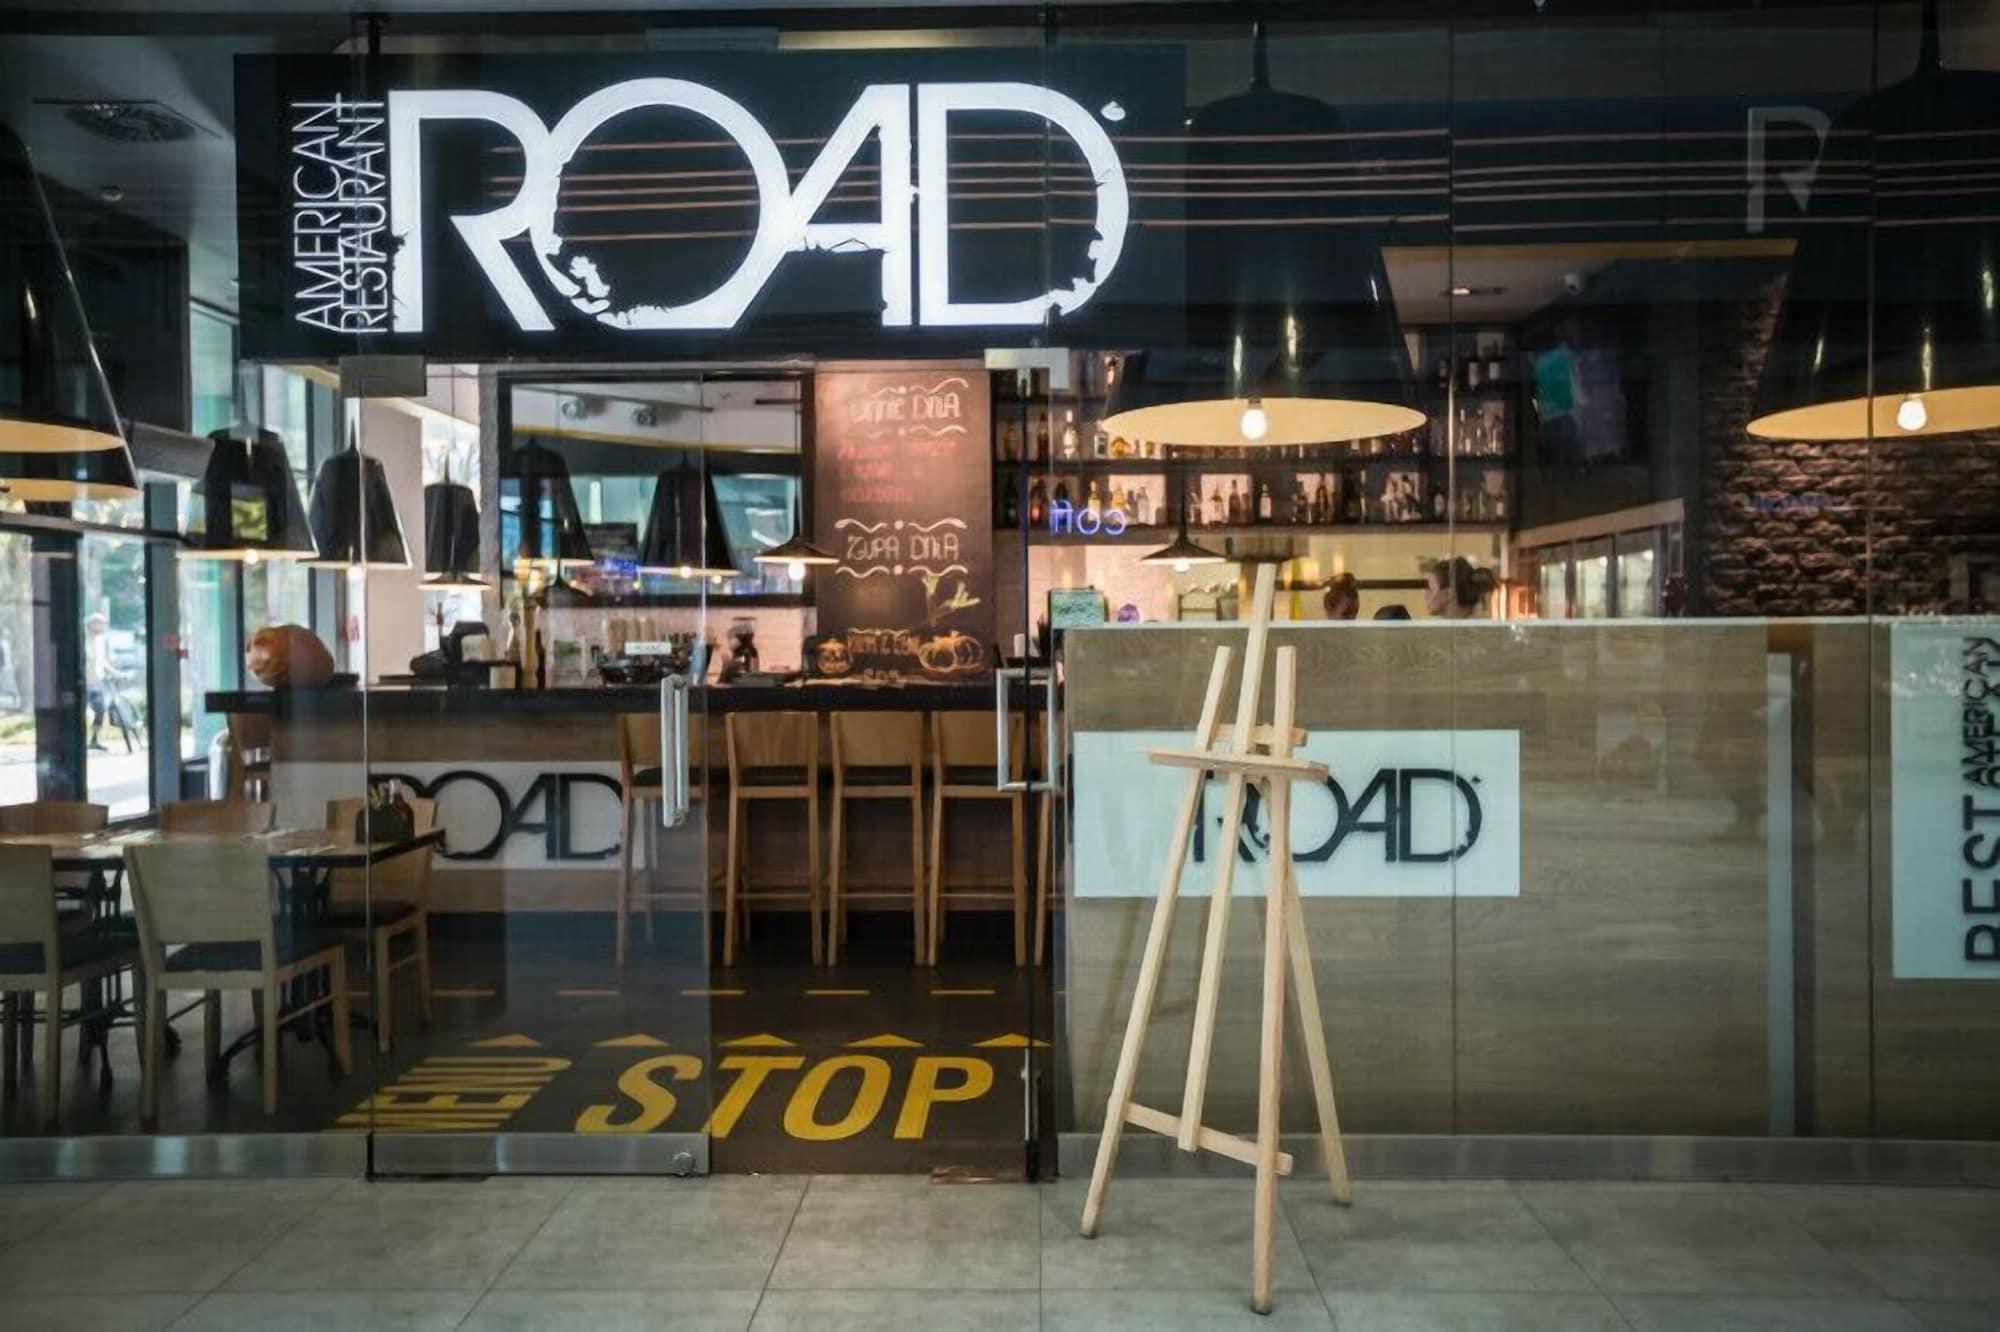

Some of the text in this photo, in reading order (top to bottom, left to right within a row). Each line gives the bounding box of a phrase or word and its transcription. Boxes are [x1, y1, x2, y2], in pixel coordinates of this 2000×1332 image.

[291, 101, 341, 332] AMERICAN
[336, 93, 388, 332] RESTAURANT
[388, 77, 1129, 332] ROAD
[574, 1054, 994, 1141] STOP
